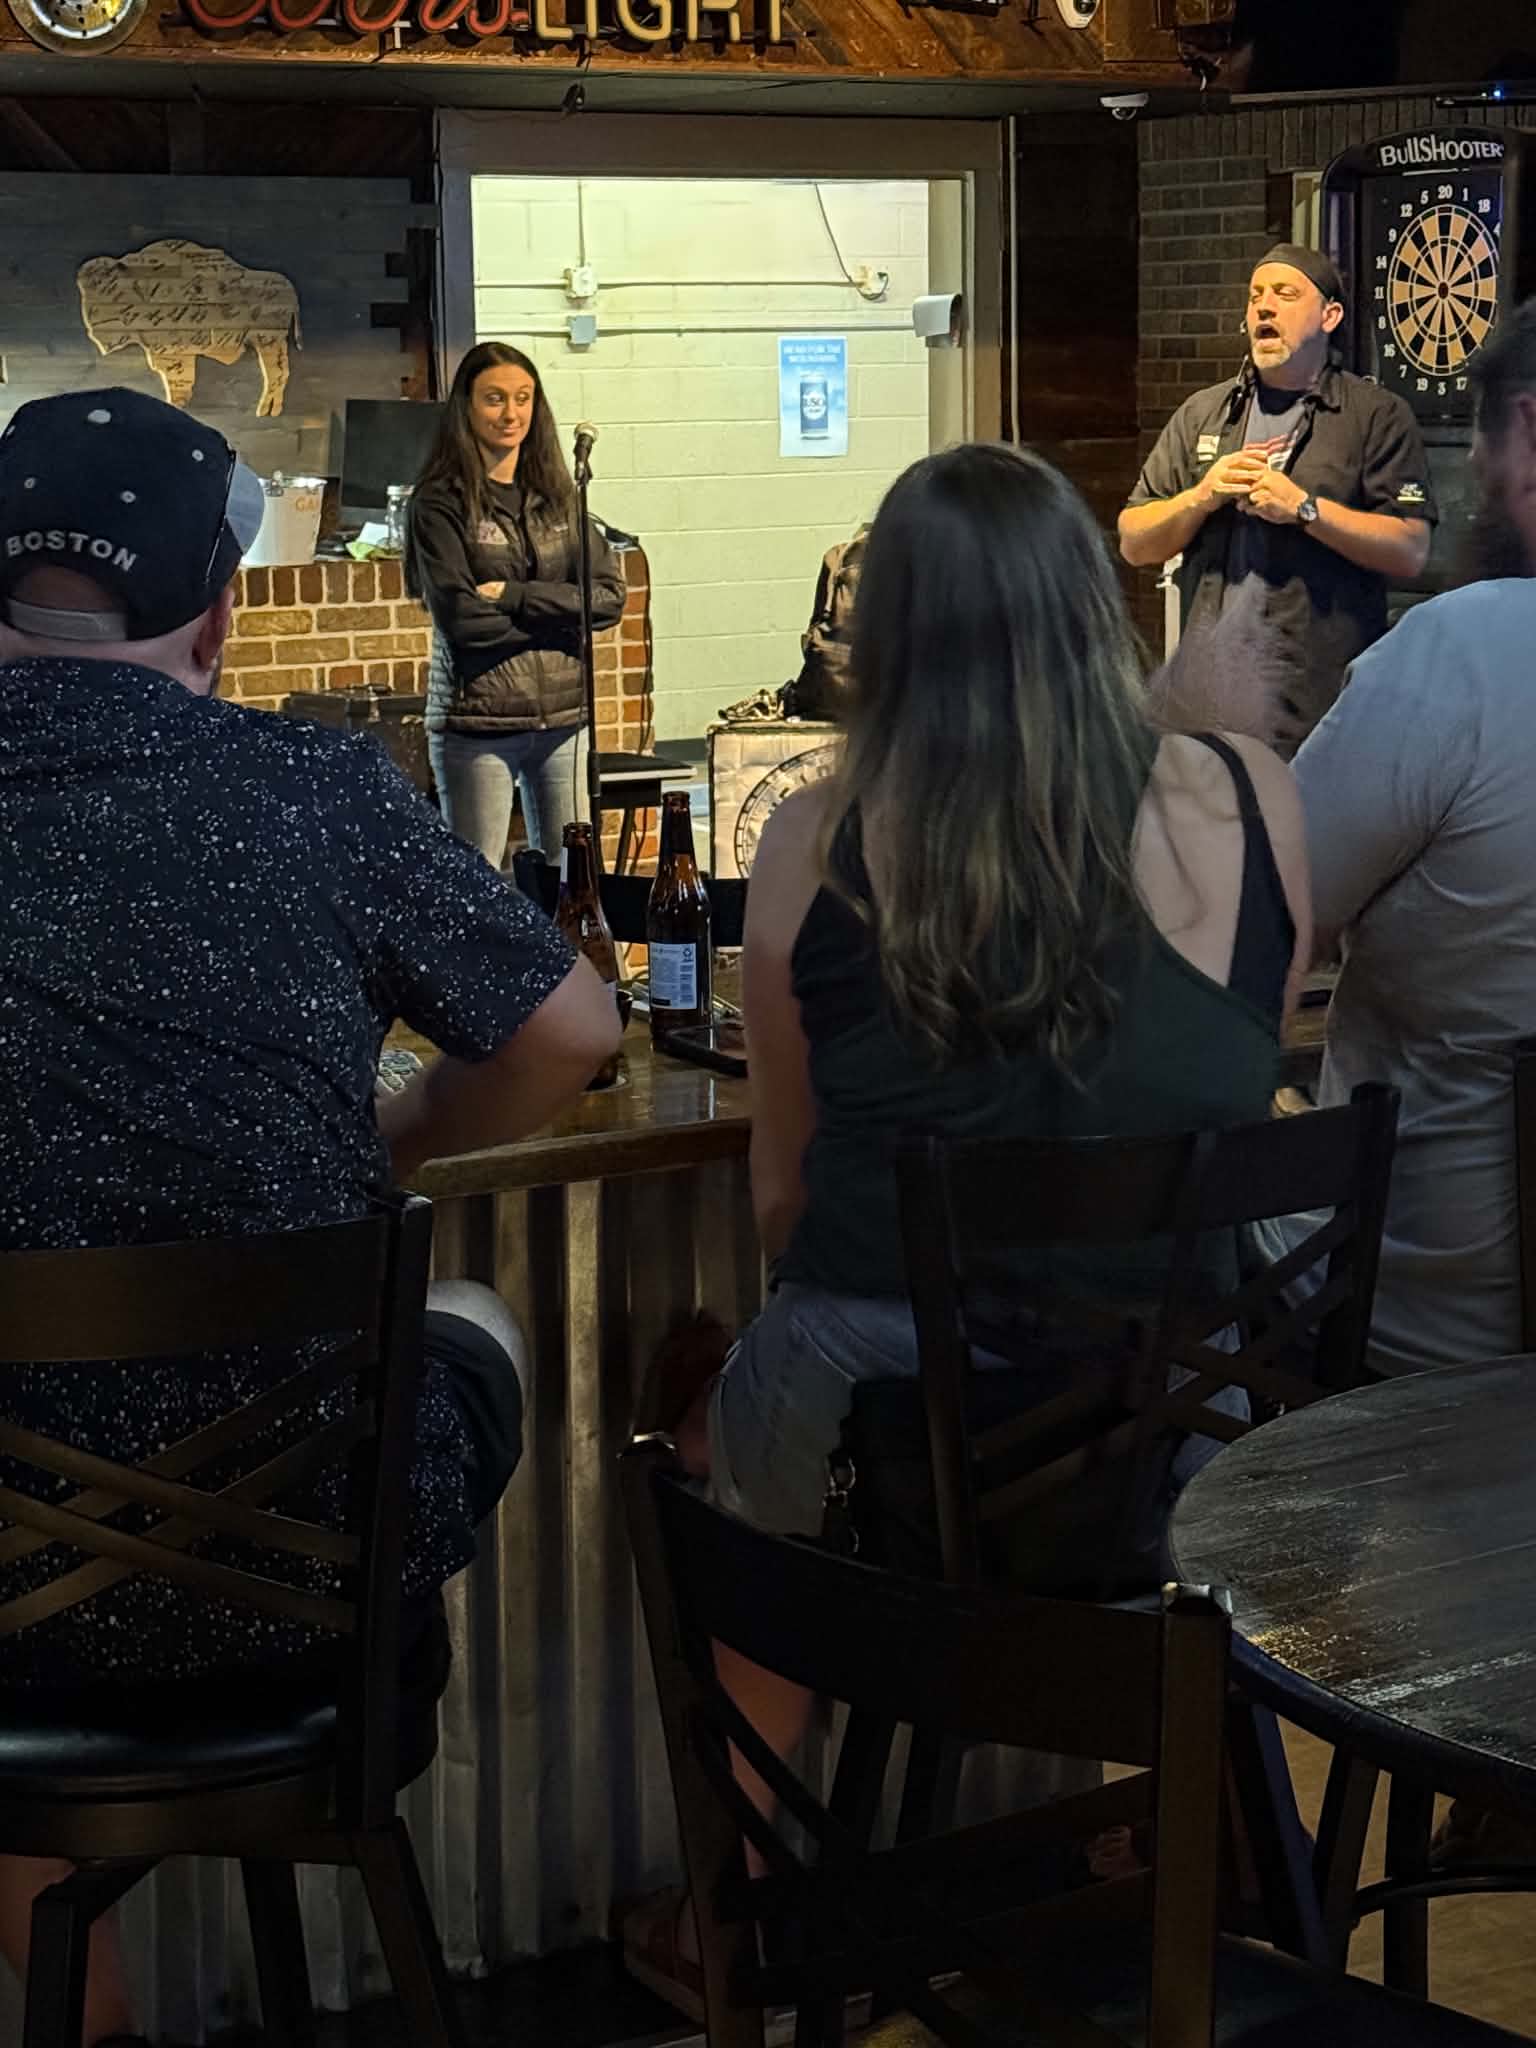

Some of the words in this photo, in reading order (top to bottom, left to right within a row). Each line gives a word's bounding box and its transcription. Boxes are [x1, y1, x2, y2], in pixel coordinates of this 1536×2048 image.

[1420, 190, 1429, 204] 5
[1438, 184, 1453, 199] 20
[1462, 187, 1468, 201] 1
[1400, 203, 1413, 217] 12
[1388, 228, 1397, 242] 9
[1376, 256, 1387, 269] 14
[1374, 286, 1384, 299] 11
[1400, 365, 1407, 378] 7
[1417, 378, 1428, 391] 19
[1438, 382, 1446, 395] 3
[1456, 377, 1467, 390] 17
[6, 529, 137, 572] BOSTON
